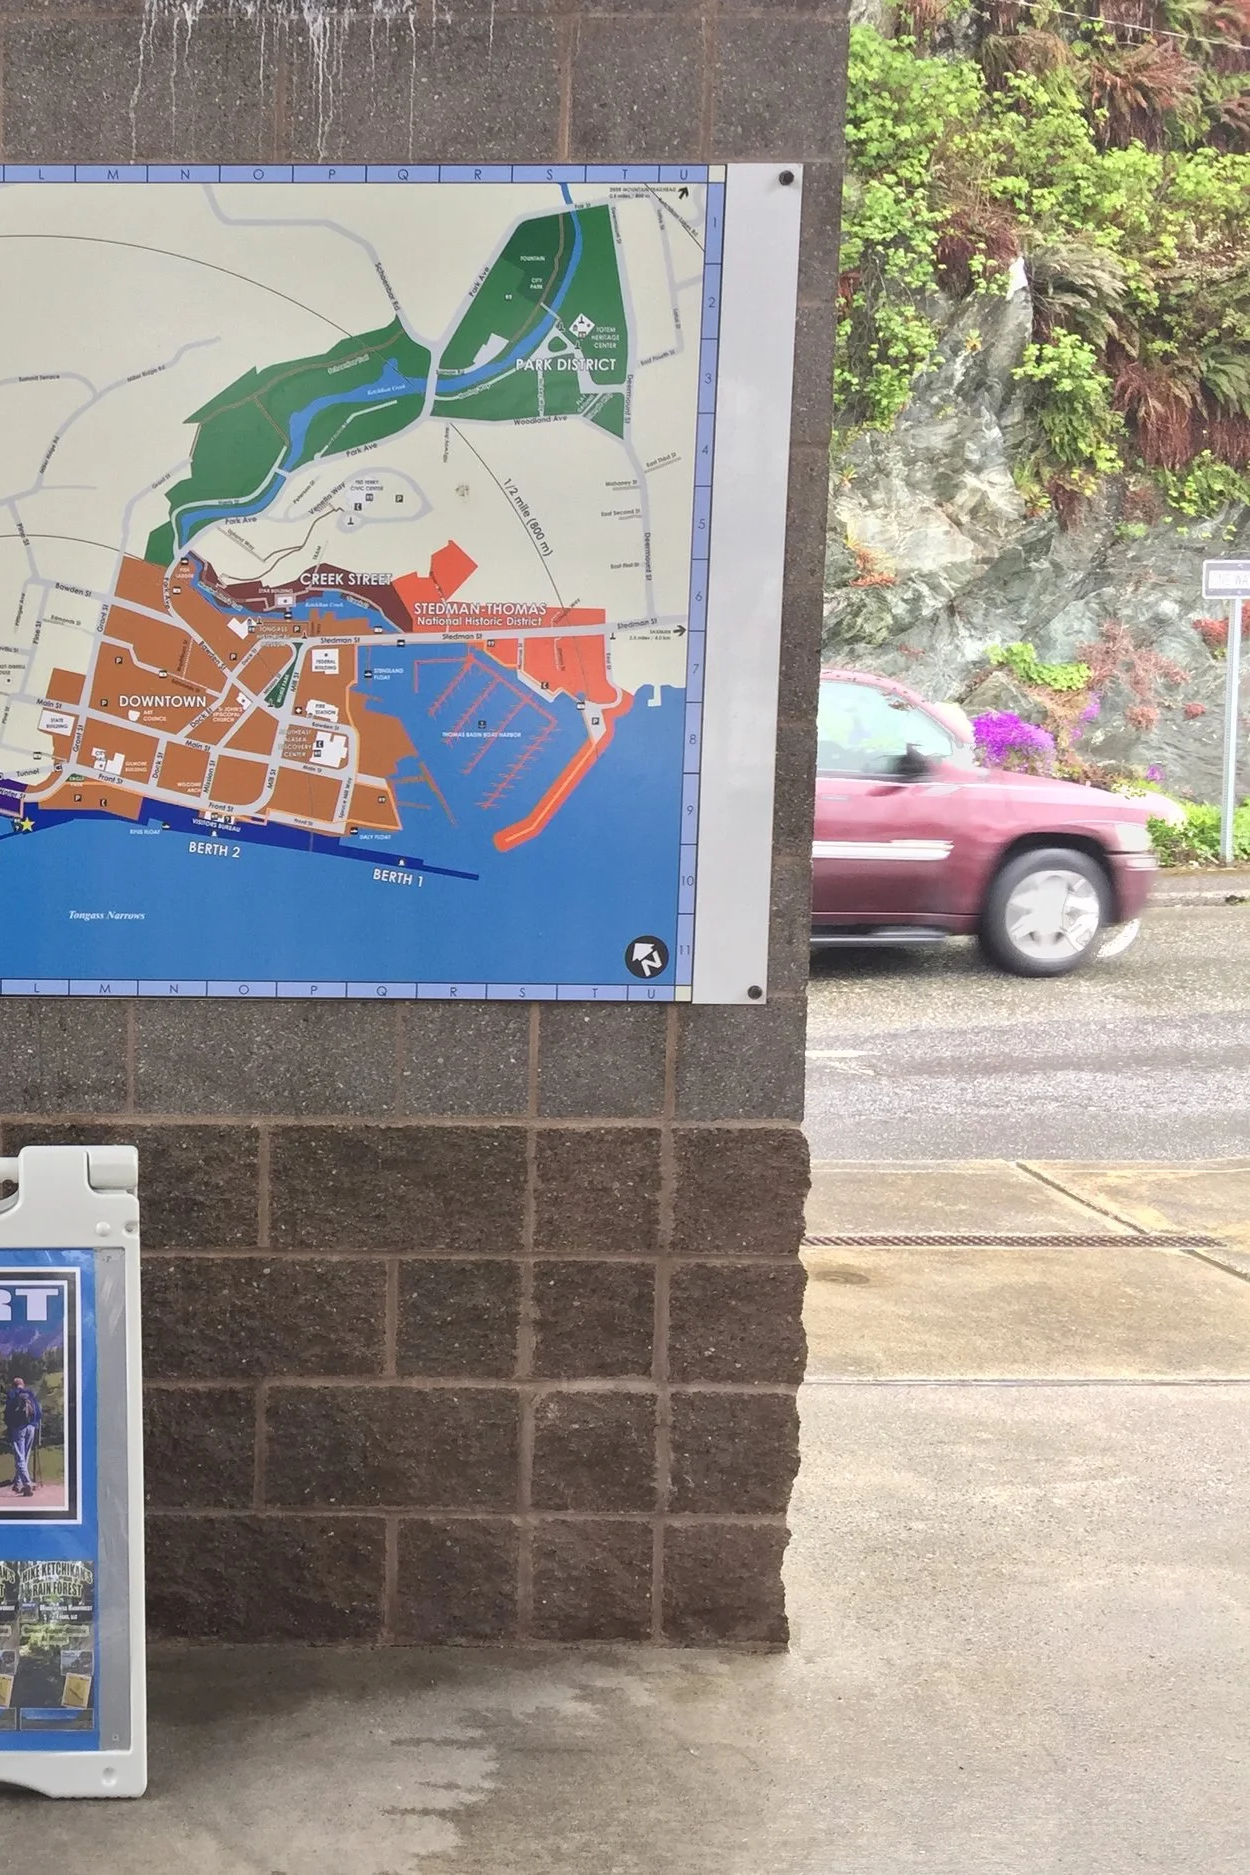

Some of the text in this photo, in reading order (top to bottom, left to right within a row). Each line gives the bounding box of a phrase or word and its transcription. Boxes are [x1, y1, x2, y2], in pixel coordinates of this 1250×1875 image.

[468, 266, 490, 298] Park Ave
[516, 358, 616, 370] PARK DISTRICT
[514, 415, 551, 426] Woodland
[346, 442, 378, 458] Park Ave
[504, 478, 554, 556] 1/2 mile (800 m)
[300, 573, 392, 586] CREEK STREET
[1234, 573, 1250, 586] WA
[55, 582, 92, 598] Bawden St
[414, 602, 546, 616] STEDMAN-THOMAS
[417, 616, 542, 626] National Historic District
[617, 618, 658, 630] Stedman St
[36, 698, 62, 710] Main St
[120, 696, 206, 708] DOWNTOWN
[185, 740, 202, 750] Main
[16, 768, 40, 777] Tunnel
[98, 774, 124, 785] Front St
[189, 841, 240, 858] BERTH 2
[373, 868, 424, 888] BERTH 1
[68, 910, 145, 920] Tongass Narrows
[22, 1564, 40, 1582] HIKE
[32, 1581, 82, 1597] RAIN FOREST
